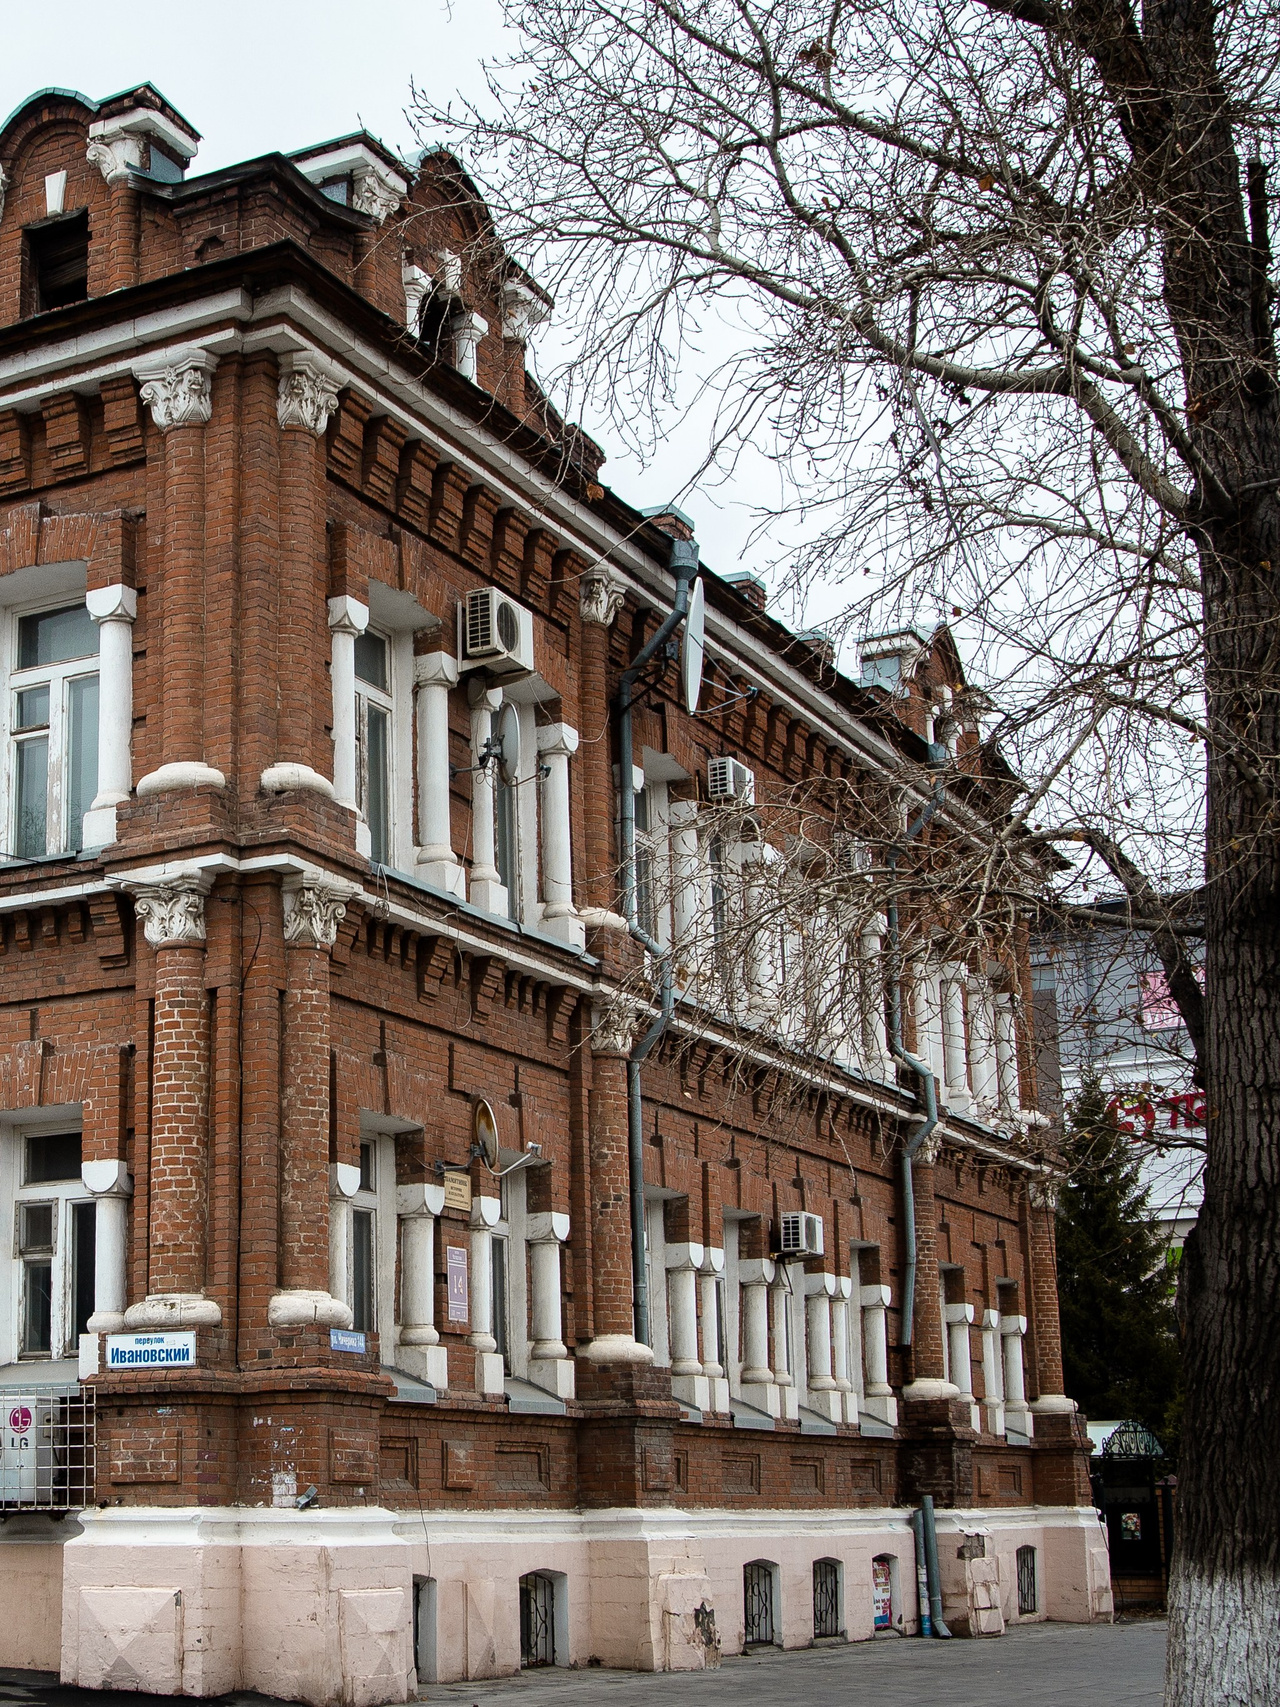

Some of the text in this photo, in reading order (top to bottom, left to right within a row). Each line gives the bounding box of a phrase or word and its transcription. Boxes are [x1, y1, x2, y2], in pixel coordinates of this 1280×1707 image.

[134, 1336, 165, 1346] переулок
[111, 1343, 190, 1364] Ивановский
[11, 1437, 29, 1451] LG
